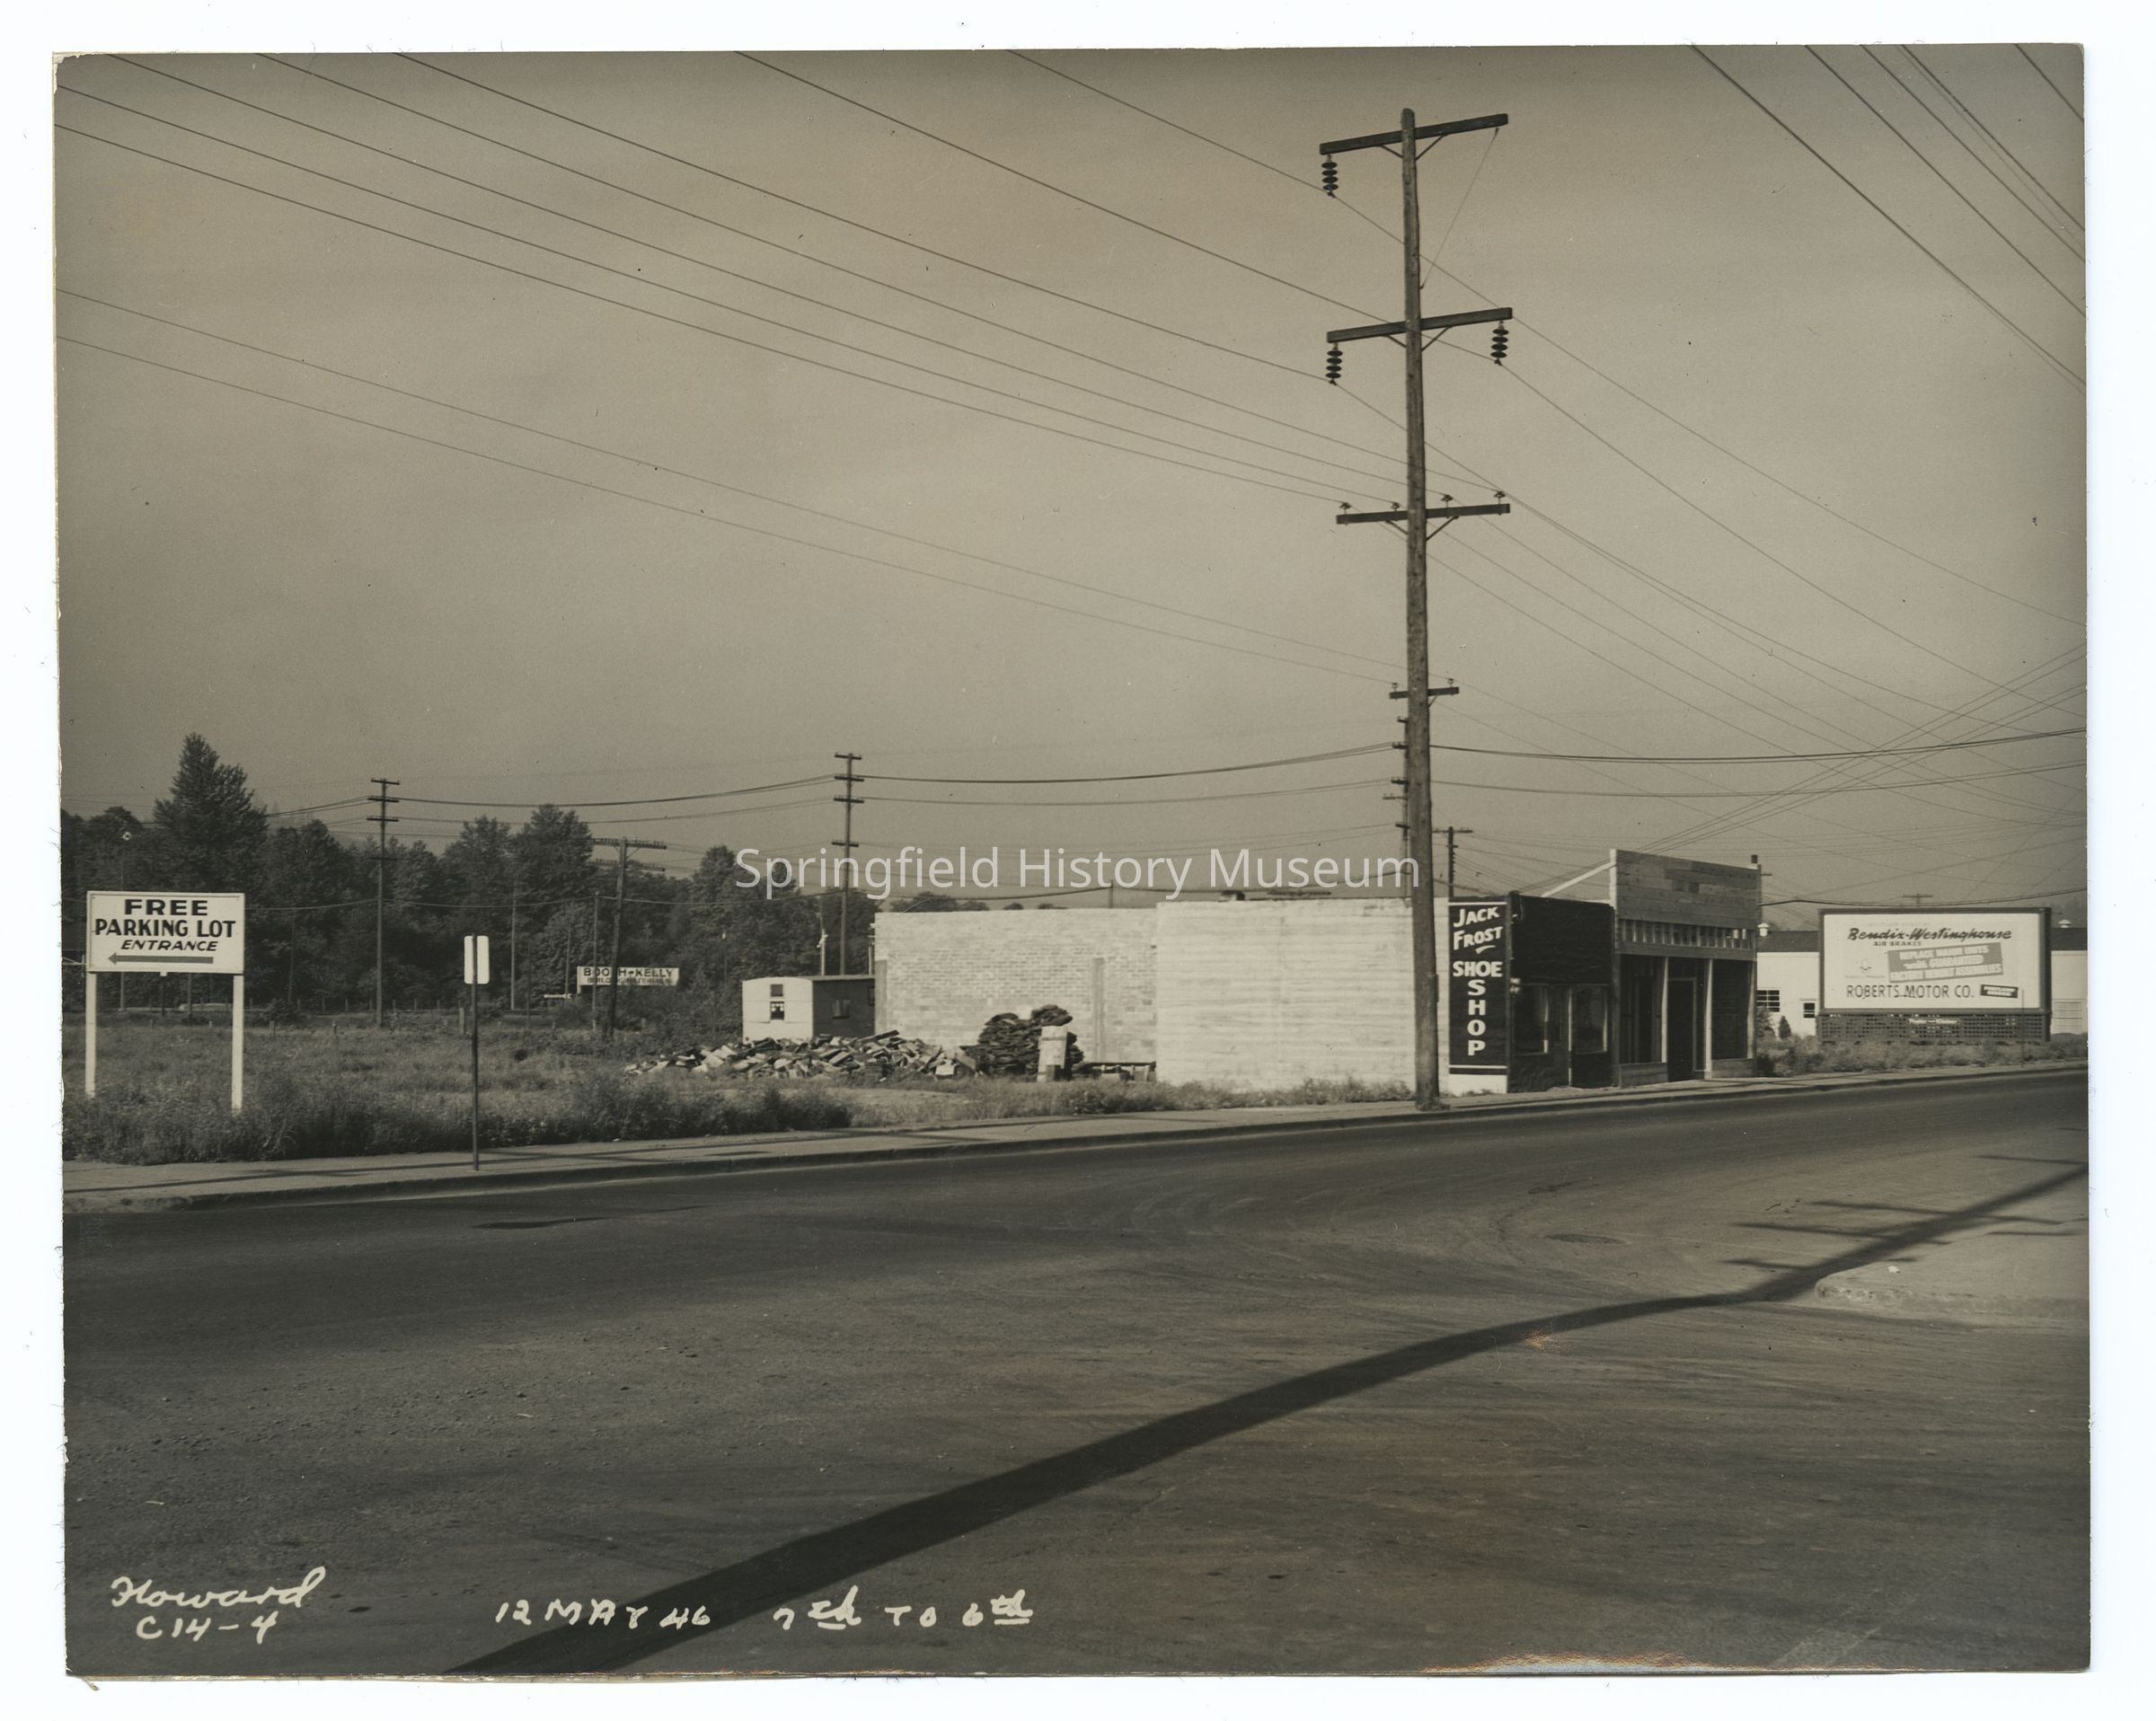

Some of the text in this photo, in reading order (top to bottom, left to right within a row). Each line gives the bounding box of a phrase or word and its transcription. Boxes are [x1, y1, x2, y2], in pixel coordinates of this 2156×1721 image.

[124, 898, 208, 916] FREE
[1453, 906, 1500, 928] JACK
[94, 918, 236, 938] PARKING LOT
[1847, 927, 2012, 942] Bendix-Westinghouse
[119, 940, 218, 952] ENTRANCE
[1453, 926, 1503, 950] FROST
[584, 967, 673, 977] BOOH-KELLY
[1452, 960, 1503, 977] SHOE
[1846, 984, 1899, 998] ROBERTS
[1904, 984, 1948, 998] MOTOR
[1954, 984, 1975, 998] CO.
[1467, 979, 1487, 1056] SHOP
[110, 1566, 326, 1609] Howard
[495, 1599, 533, 1626] 12
[544, 1599, 649, 1629] MAY
[658, 1605, 711, 1630] 46
[884, 1605, 937, 1628] TO
